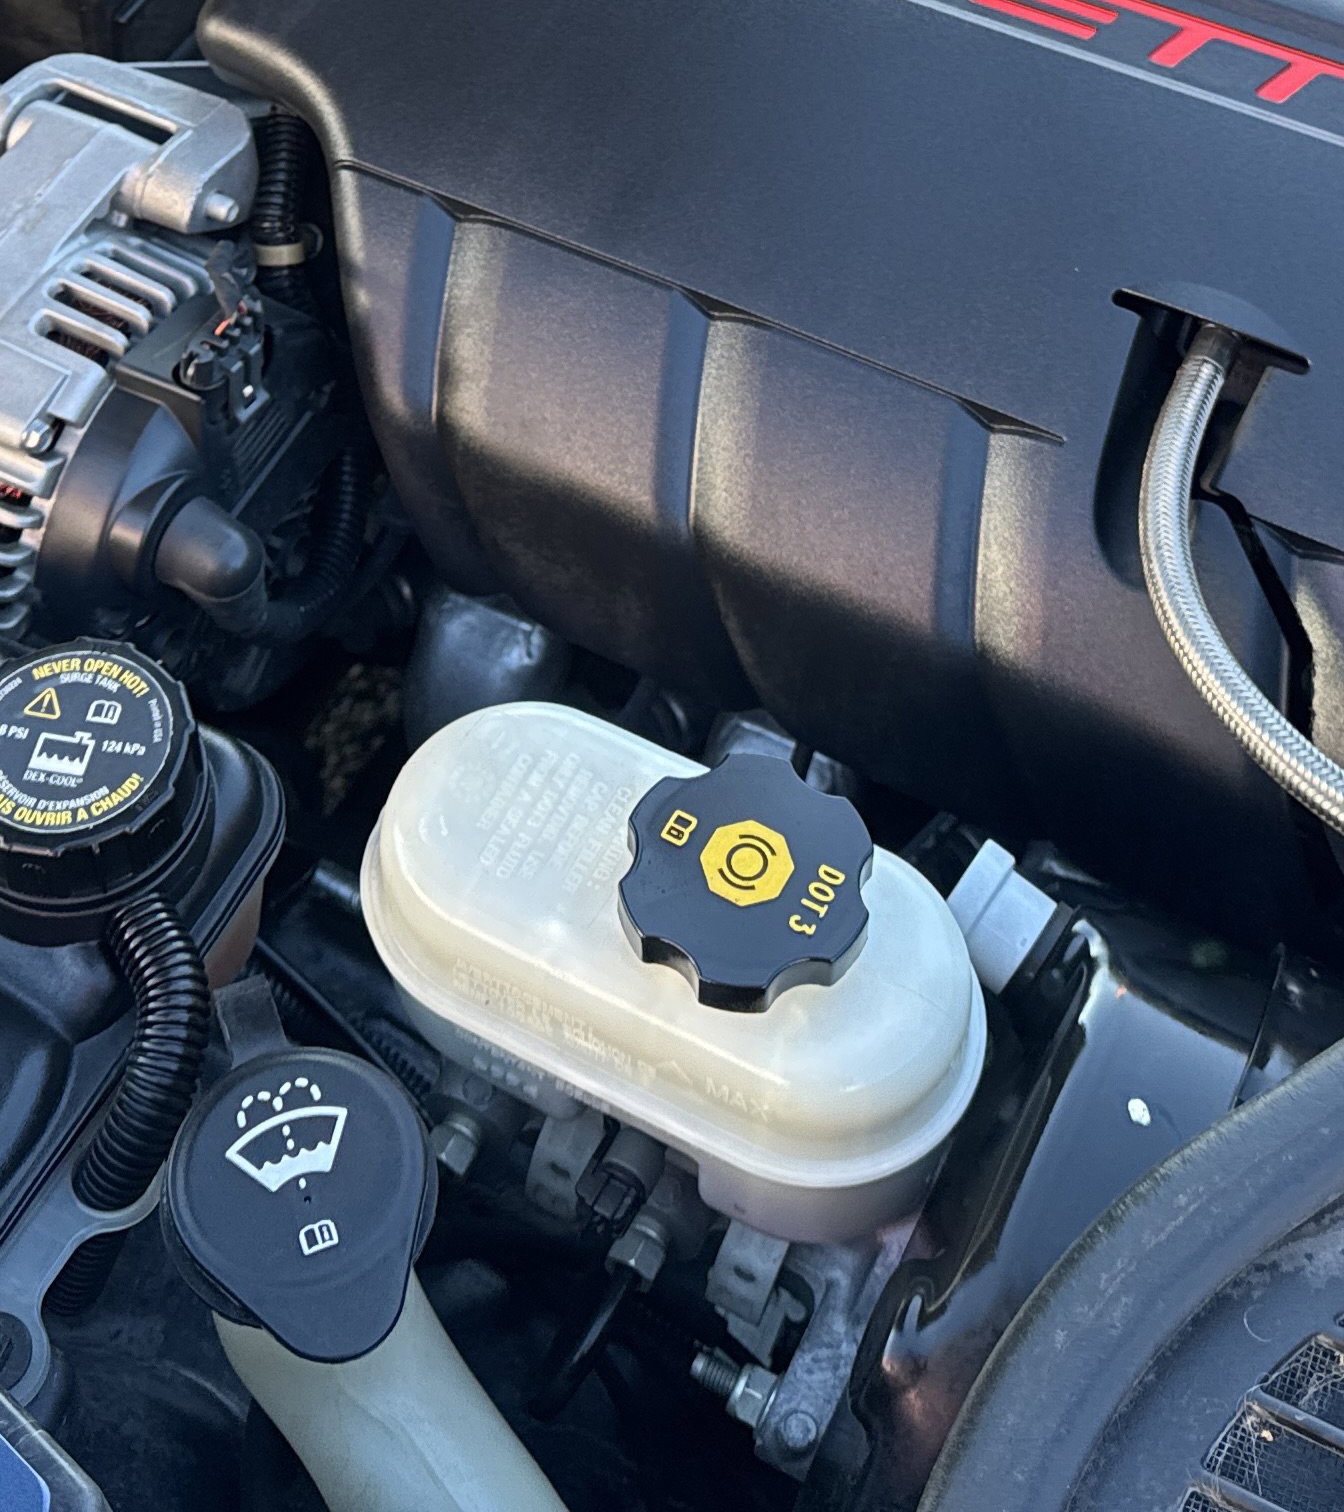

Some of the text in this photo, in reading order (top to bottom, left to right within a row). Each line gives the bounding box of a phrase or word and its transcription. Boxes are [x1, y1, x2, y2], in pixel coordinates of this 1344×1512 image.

[32, 657, 150, 698] NEVER OPEN HOT!
[59, 672, 120, 694] SURGE TANK
[6, 725, 30, 740] PSI
[101, 740, 146, 756] 124 kPa
[13, 806, 73, 826] OUVRIR
[90, 772, 145, 817] CHAUD!
[581, 781, 609, 811] CAP
[594, 786, 632, 834] CLEAN
[788, 864, 846, 936] DOT 3
